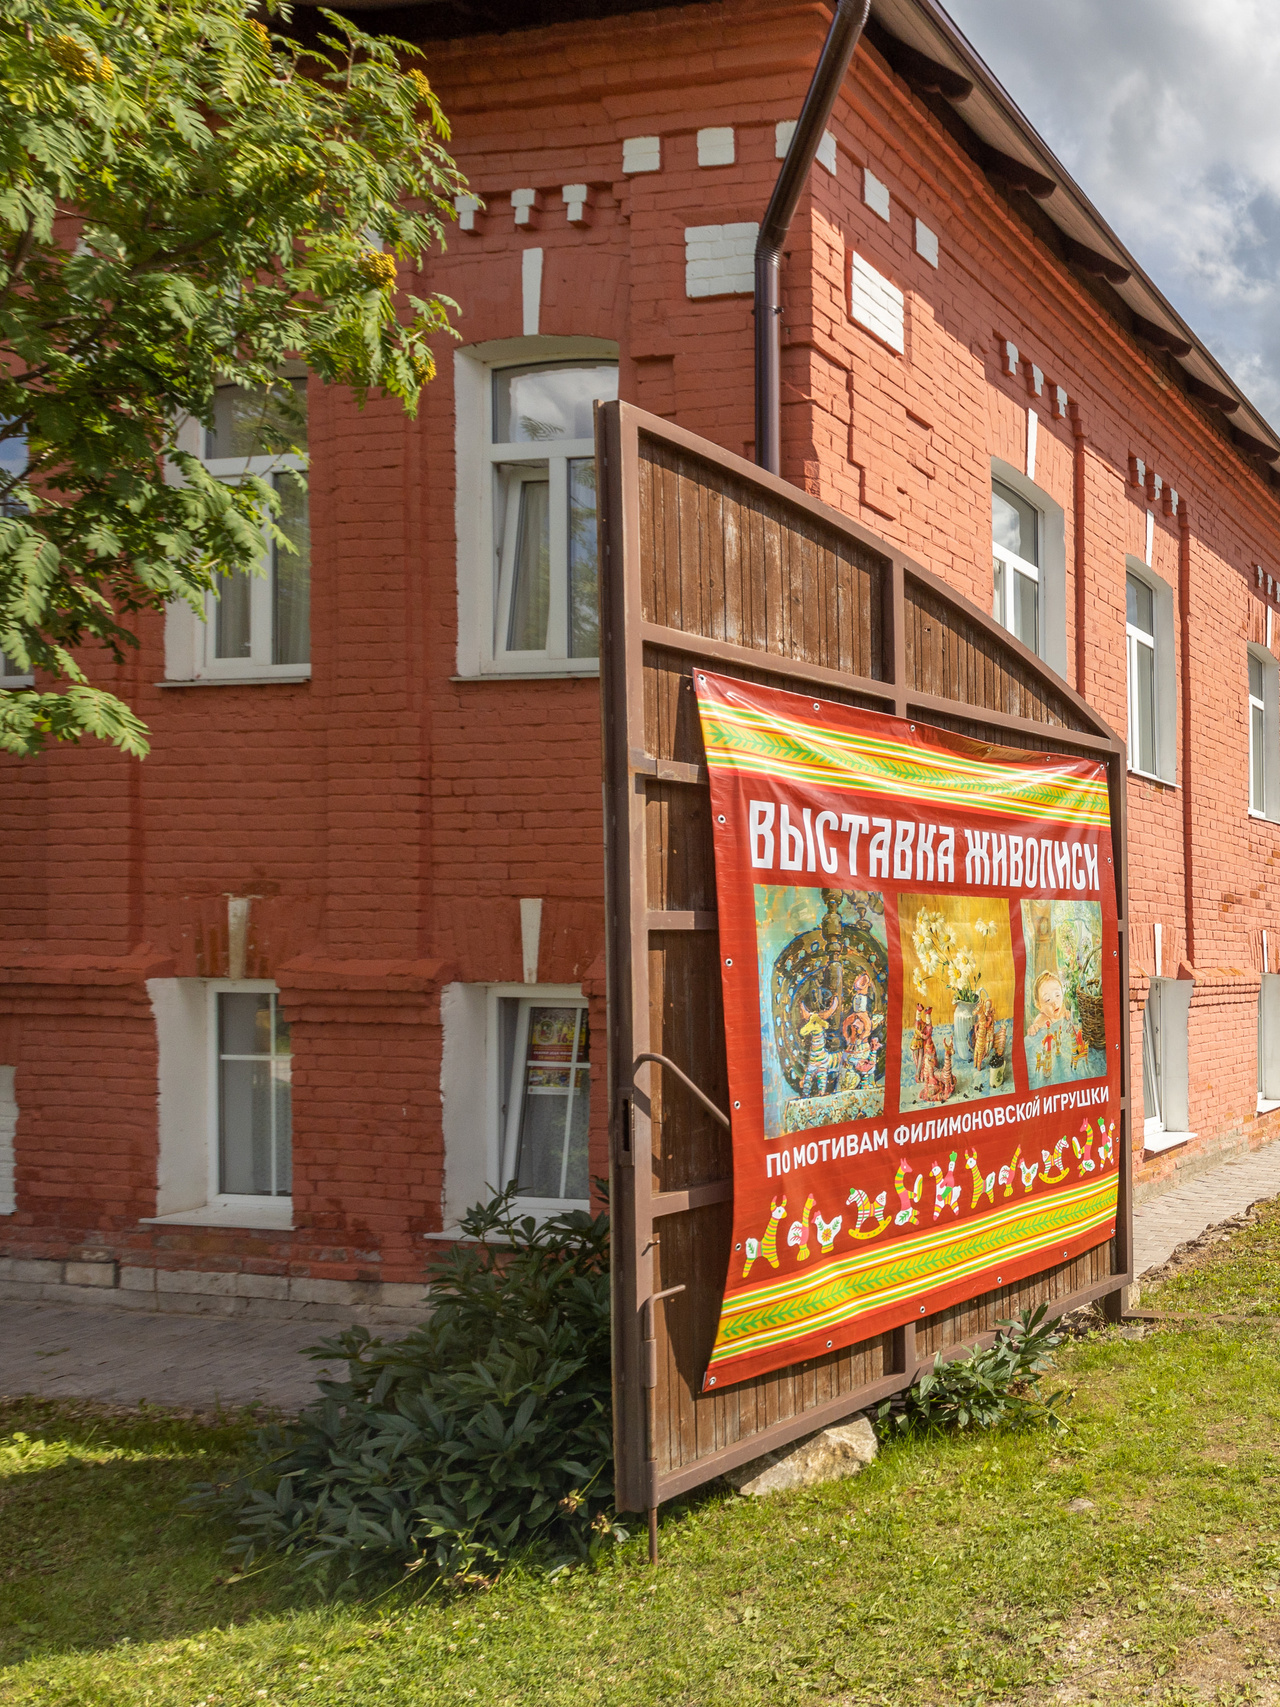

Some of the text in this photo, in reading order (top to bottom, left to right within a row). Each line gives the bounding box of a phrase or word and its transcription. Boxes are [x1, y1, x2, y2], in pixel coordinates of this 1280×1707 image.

[750, 799, 1100, 891] ВЫСТАВКА ЖИВОПИСИ
[766, 1086, 1109, 1178] ПО МОТИВАМ ФИЛИМОНОВСКОЙ ИГРУШКИ
